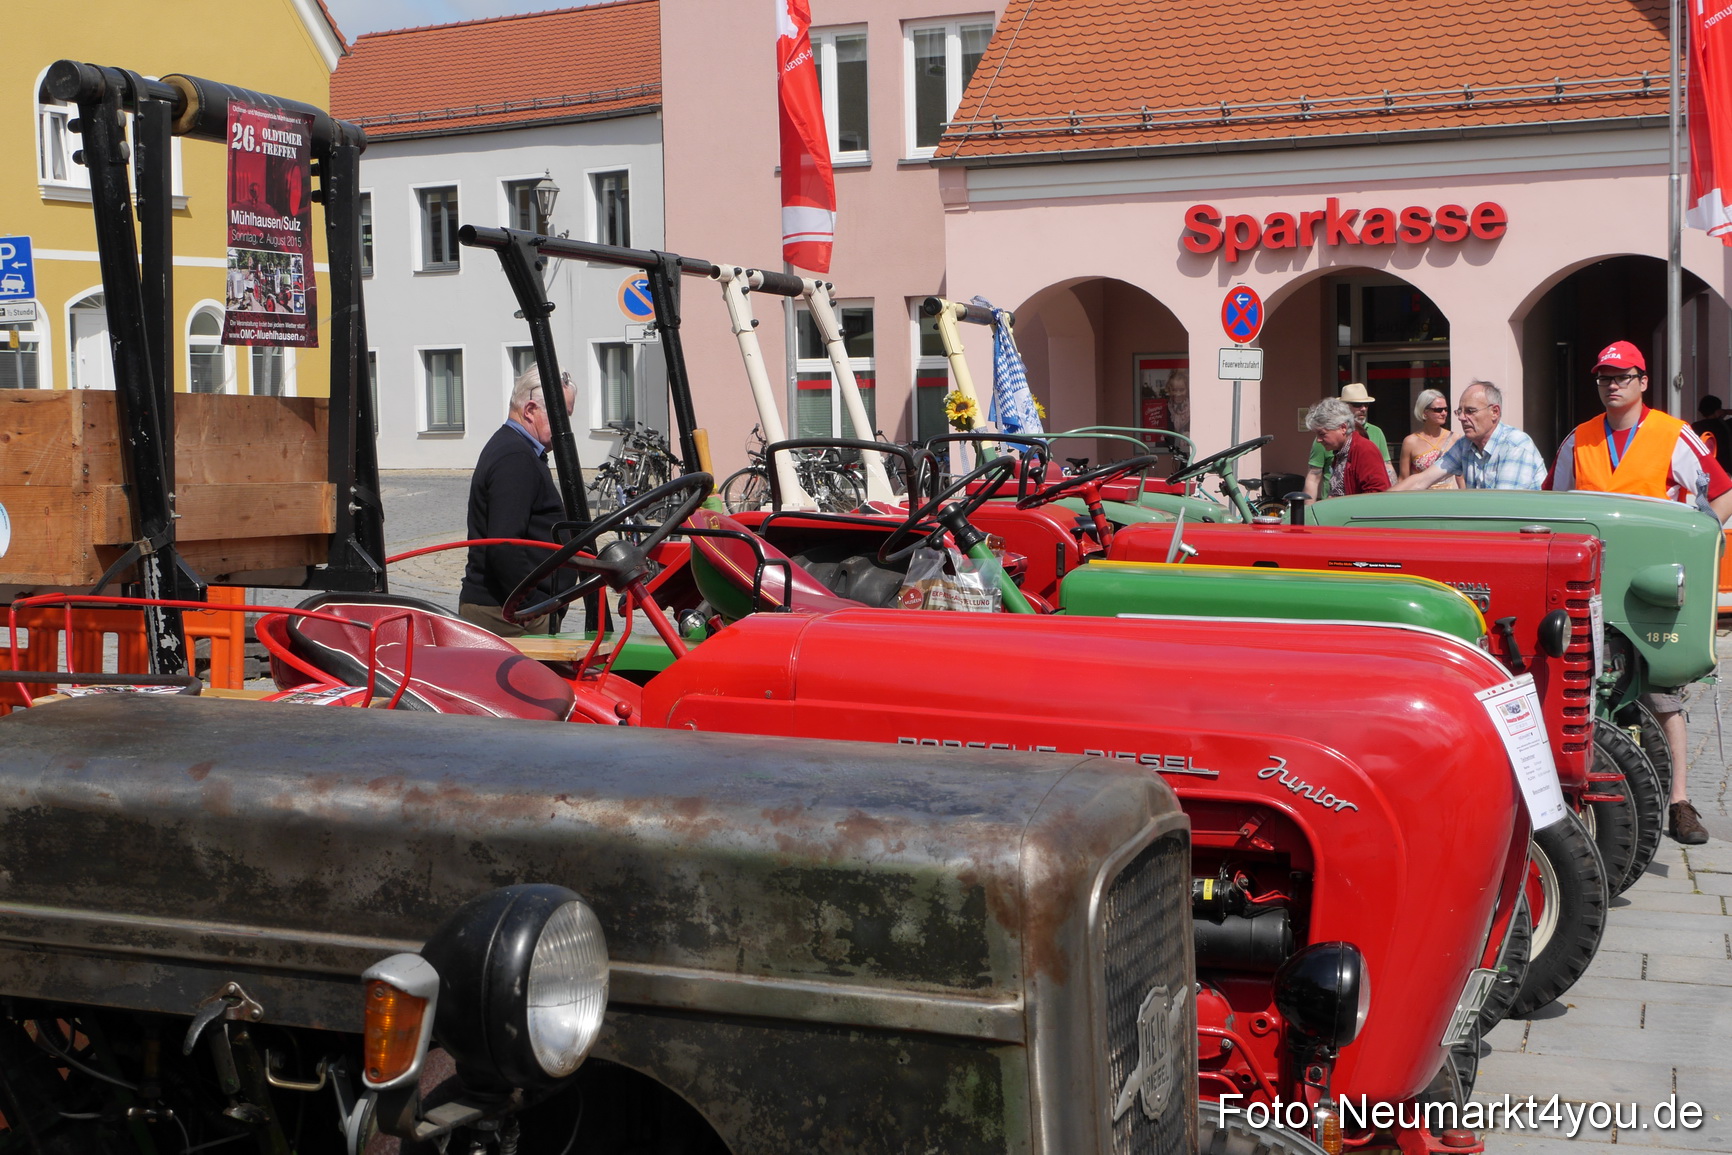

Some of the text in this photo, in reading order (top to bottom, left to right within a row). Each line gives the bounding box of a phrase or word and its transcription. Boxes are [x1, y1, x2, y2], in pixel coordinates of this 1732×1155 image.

[231, 122, 261, 153] 26.
[261, 127, 303, 147] OLDTIMER
[261, 142, 297, 160] TREFFEN
[231, 209, 302, 232] Mühlhausen/Sulz
[1183, 197, 1508, 263] Sparkasse
[232, 229, 258, 246] Sonntag,
[266, 233, 287, 248] August
[287, 236, 303, 248] 2015
[0, 243, 16, 270] P
[13, 307, 34, 317] Stunde
[1222, 359, 1260, 369] Feuerwehrzufahrt
[1646, 632, 1679, 643] 18 PS
[1257, 755, 1359, 812] Junior
